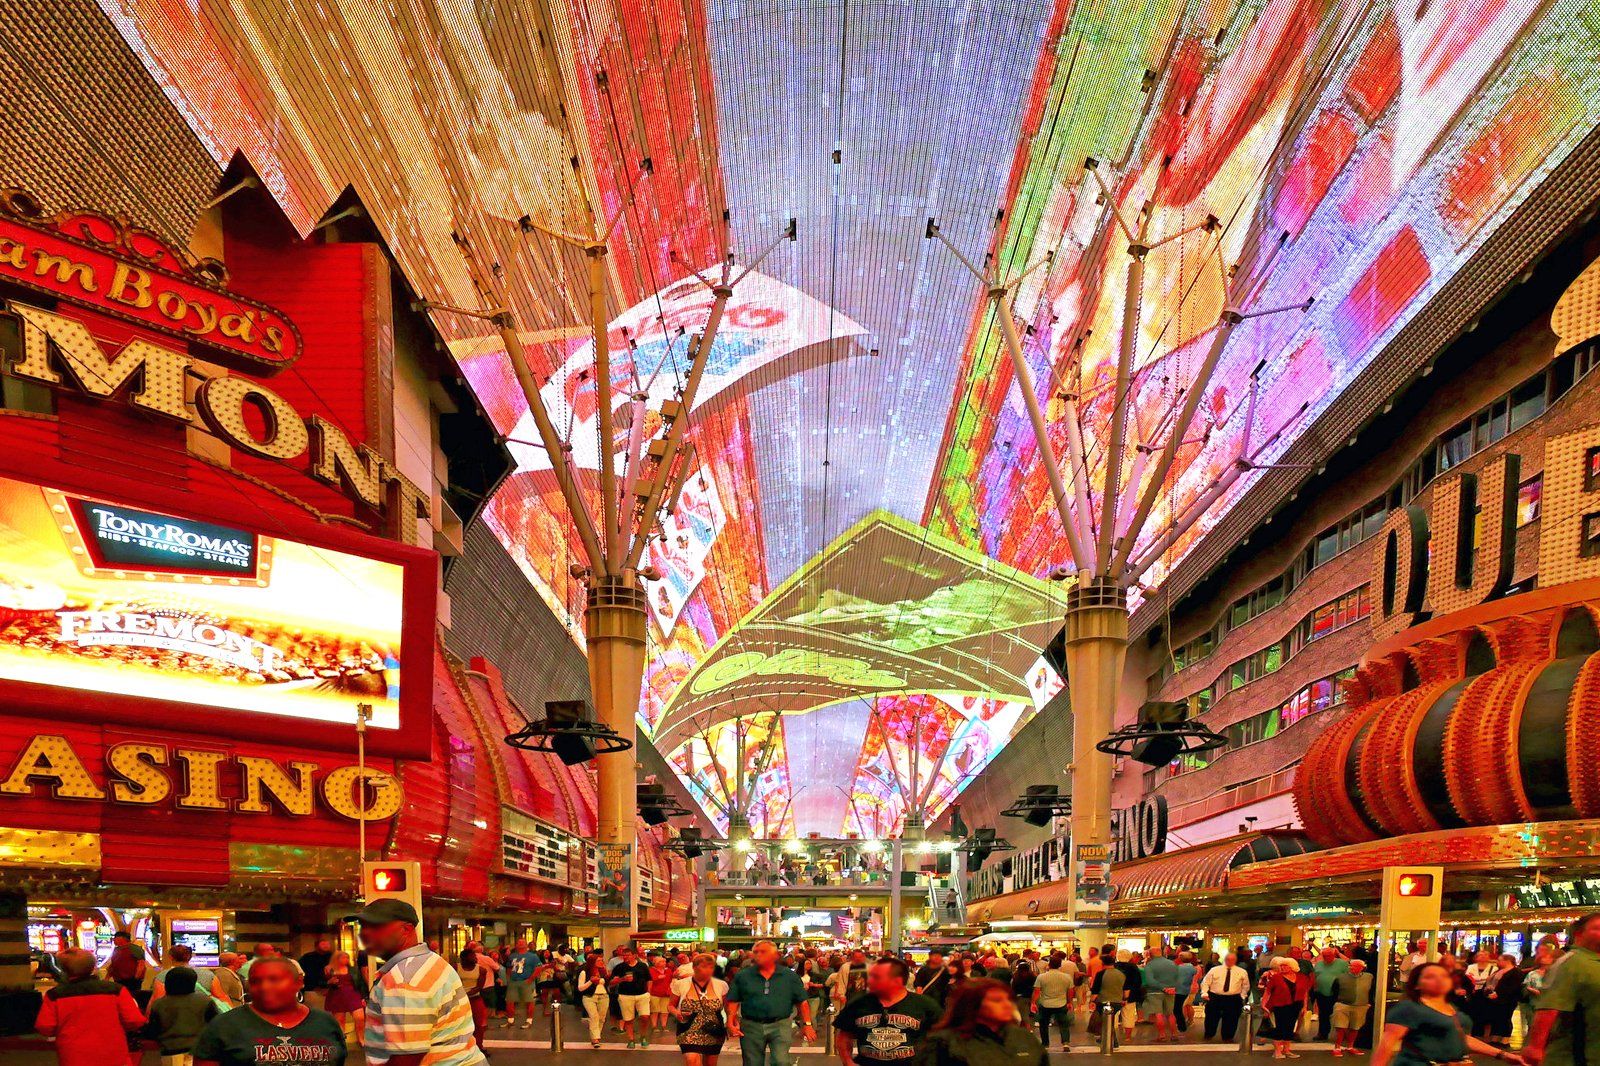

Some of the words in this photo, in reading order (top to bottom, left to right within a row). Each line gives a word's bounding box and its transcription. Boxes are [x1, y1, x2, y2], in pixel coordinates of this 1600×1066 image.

[106, 262, 285, 354] Boyd's
[98, 530, 131, 543] RIBS
[138, 540, 196, 557] SEAFOOD
[203, 551, 249, 568] STEAKS
[55, 610, 285, 675] FREMONT
[0, 734, 404, 821] ASINO
[1011, 843, 1045, 890] HOTEL
[1080, 847, 1107, 856] NOW
[666, 931, 699, 940] CIGARS
